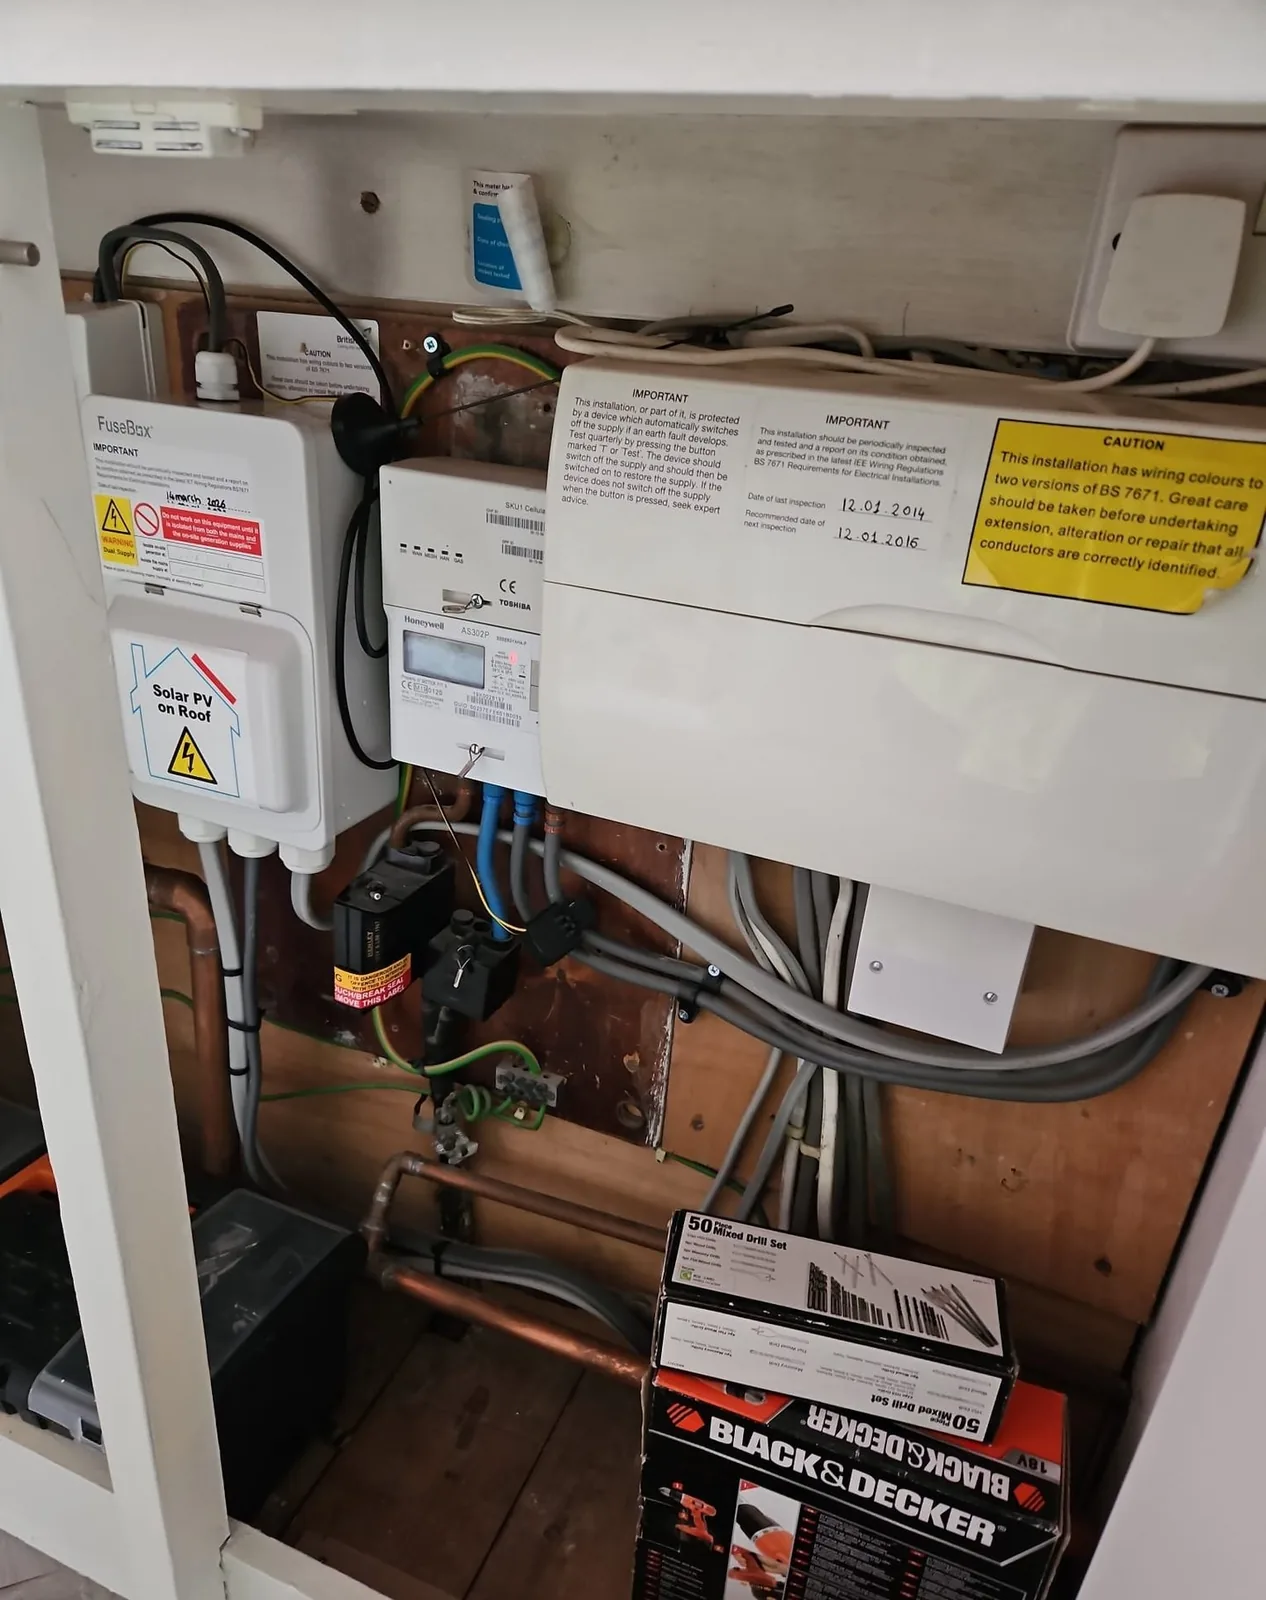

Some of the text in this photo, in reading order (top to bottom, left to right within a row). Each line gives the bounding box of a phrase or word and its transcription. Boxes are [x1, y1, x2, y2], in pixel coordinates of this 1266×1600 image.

[305, 349, 331, 358] CAUTION
[632, 388, 688, 403] IMPORTANT
[573, 397, 590, 408] This
[592, 399, 636, 413] installation,
[649, 407, 666, 416] part
[668, 409, 677, 417] of
[678, 409, 686, 419] it,
[689, 410, 696, 419] is
[697, 413, 740, 424] protected
[97, 415, 151, 438] FuseBox
[572, 408, 738, 436] by a device which automatically switches
[825, 415, 889, 429] IMPORTANT
[569, 420, 581, 430] off
[583, 420, 595, 429] the
[597, 423, 624, 435] supply
[644, 429, 665, 438] earth
[668, 431, 686, 440] fault
[688, 434, 727, 447] develops.
[569, 429, 715, 456] Test quarterly by pressing the button
[760, 426, 945, 453] This installation should be periodically inspected
[93, 442, 138, 457] IMPORTANT
[1103, 436, 1164, 450] CAUTION
[753, 457, 765, 465] BS
[767, 458, 784, 467] 7671
[787, 461, 839, 474] Requirements
[854, 469, 890, 480] Electrical
[1000, 450, 1266, 491] This installation has wiring colours to
[747, 492, 764, 500] Date
[774, 496, 787, 504] last
[788, 498, 825, 508] inspection
[994, 472, 1248, 511] two versions of BS 7671. Great care
[505, 502, 523, 512] SKU1
[989, 494, 1237, 536] should be taken before undertaking
[180, 515, 193, 523] work
[212, 522, 240, 531] equipment
[745, 509, 798, 523] Recommended
[799, 517, 815, 525] date
[172, 522, 192, 531] isolated
[206, 527, 219, 535] both
[229, 532, 244, 540] mains
[760, 522, 796, 532] inspection
[102, 536, 134, 548] WARNING
[182, 532, 199, 541] on-site
[200, 536, 229, 546] generation
[229, 541, 252, 550] supplies
[984, 518, 1243, 558] extension, alteration or repair that all
[117, 549, 135, 559] Supply
[979, 539, 1219, 578] conductors are correctly identified.
[499, 598, 531, 610] TOSHIBA
[404, 615, 444, 630] Honeywell
[461, 627, 490, 638] AS302P
[153, 684, 212, 707] Solar PV
[158, 703, 211, 722] on Roof
[361, 997, 381, 1007] THIS
[383, 985, 405, 1000] LABEL
[688, 1217, 733, 1234] 50 Piece
[713, 1226, 787, 1250] Mixed Drill Set
[871, 1394, 952, 1421] Mixed Drill Set
[930, 1415, 980, 1433] 50 Piece
[1016, 1456, 1048, 1474] 18V
